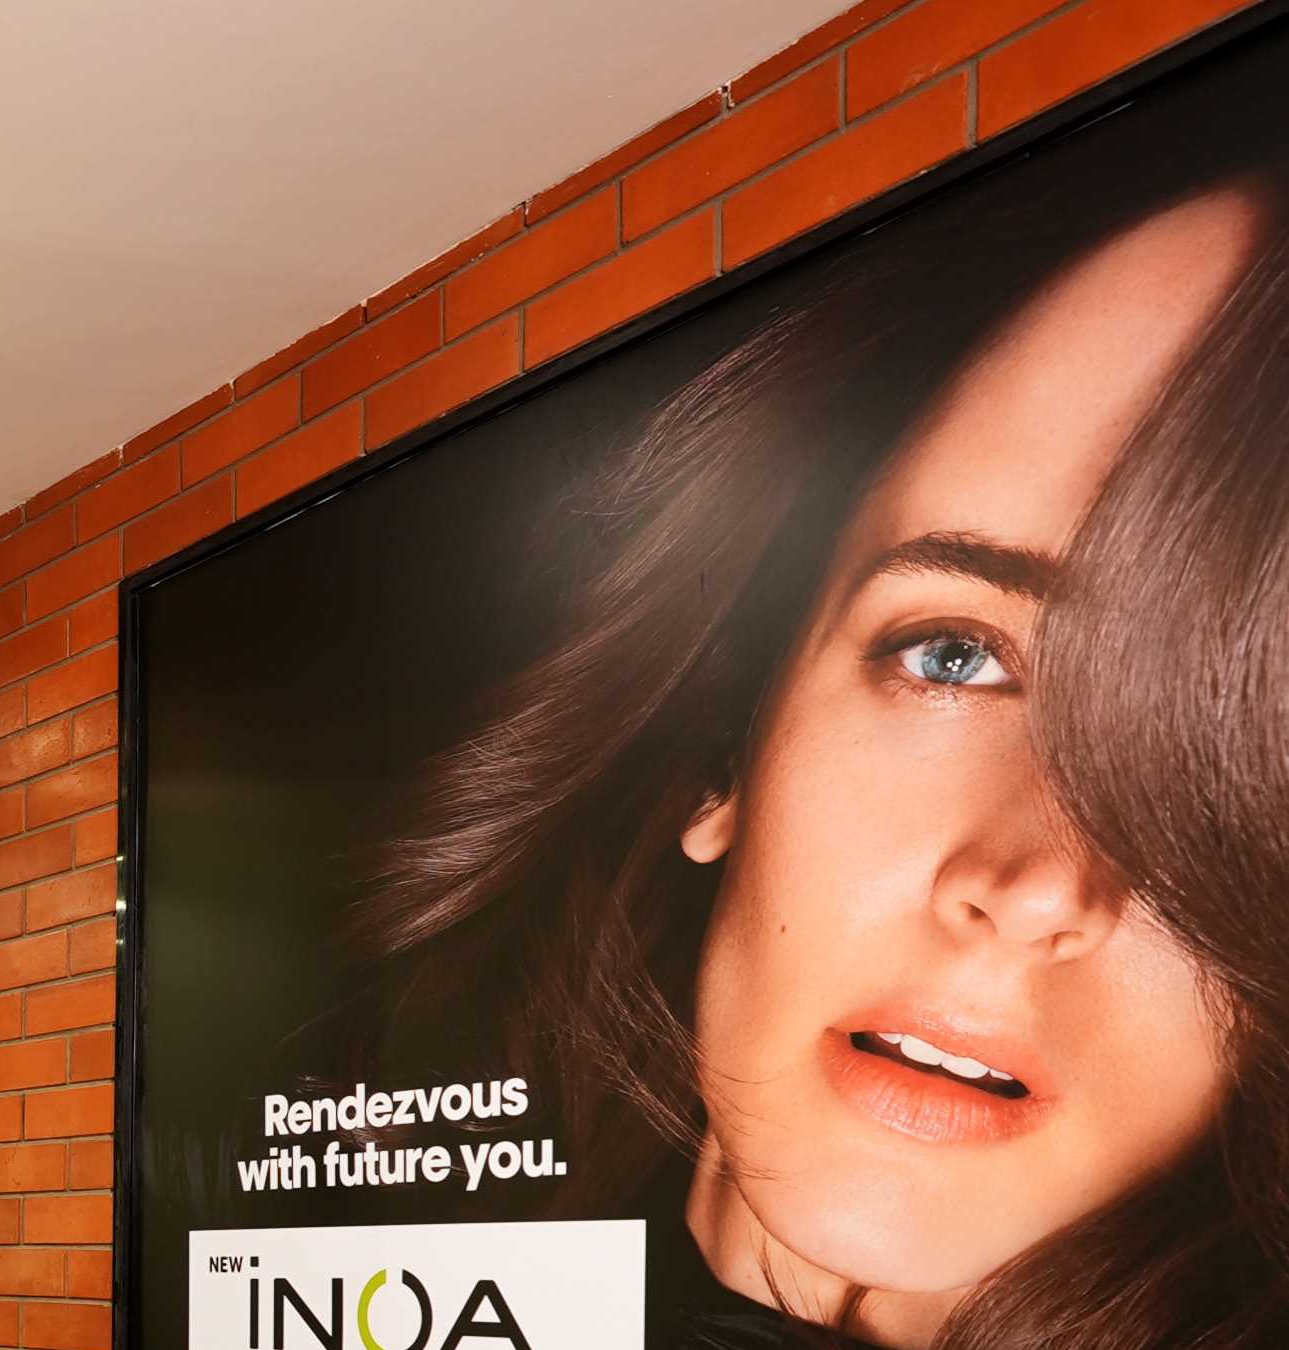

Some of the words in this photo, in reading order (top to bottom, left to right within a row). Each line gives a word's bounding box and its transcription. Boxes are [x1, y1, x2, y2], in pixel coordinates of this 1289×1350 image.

[264, 1077, 528, 1136] Rendezvous
[238, 1144, 316, 1191] with
[323, 1142, 451, 1187] future
[459, 1138, 567, 1191] you.
[209, 1255, 244, 1273] NEW
